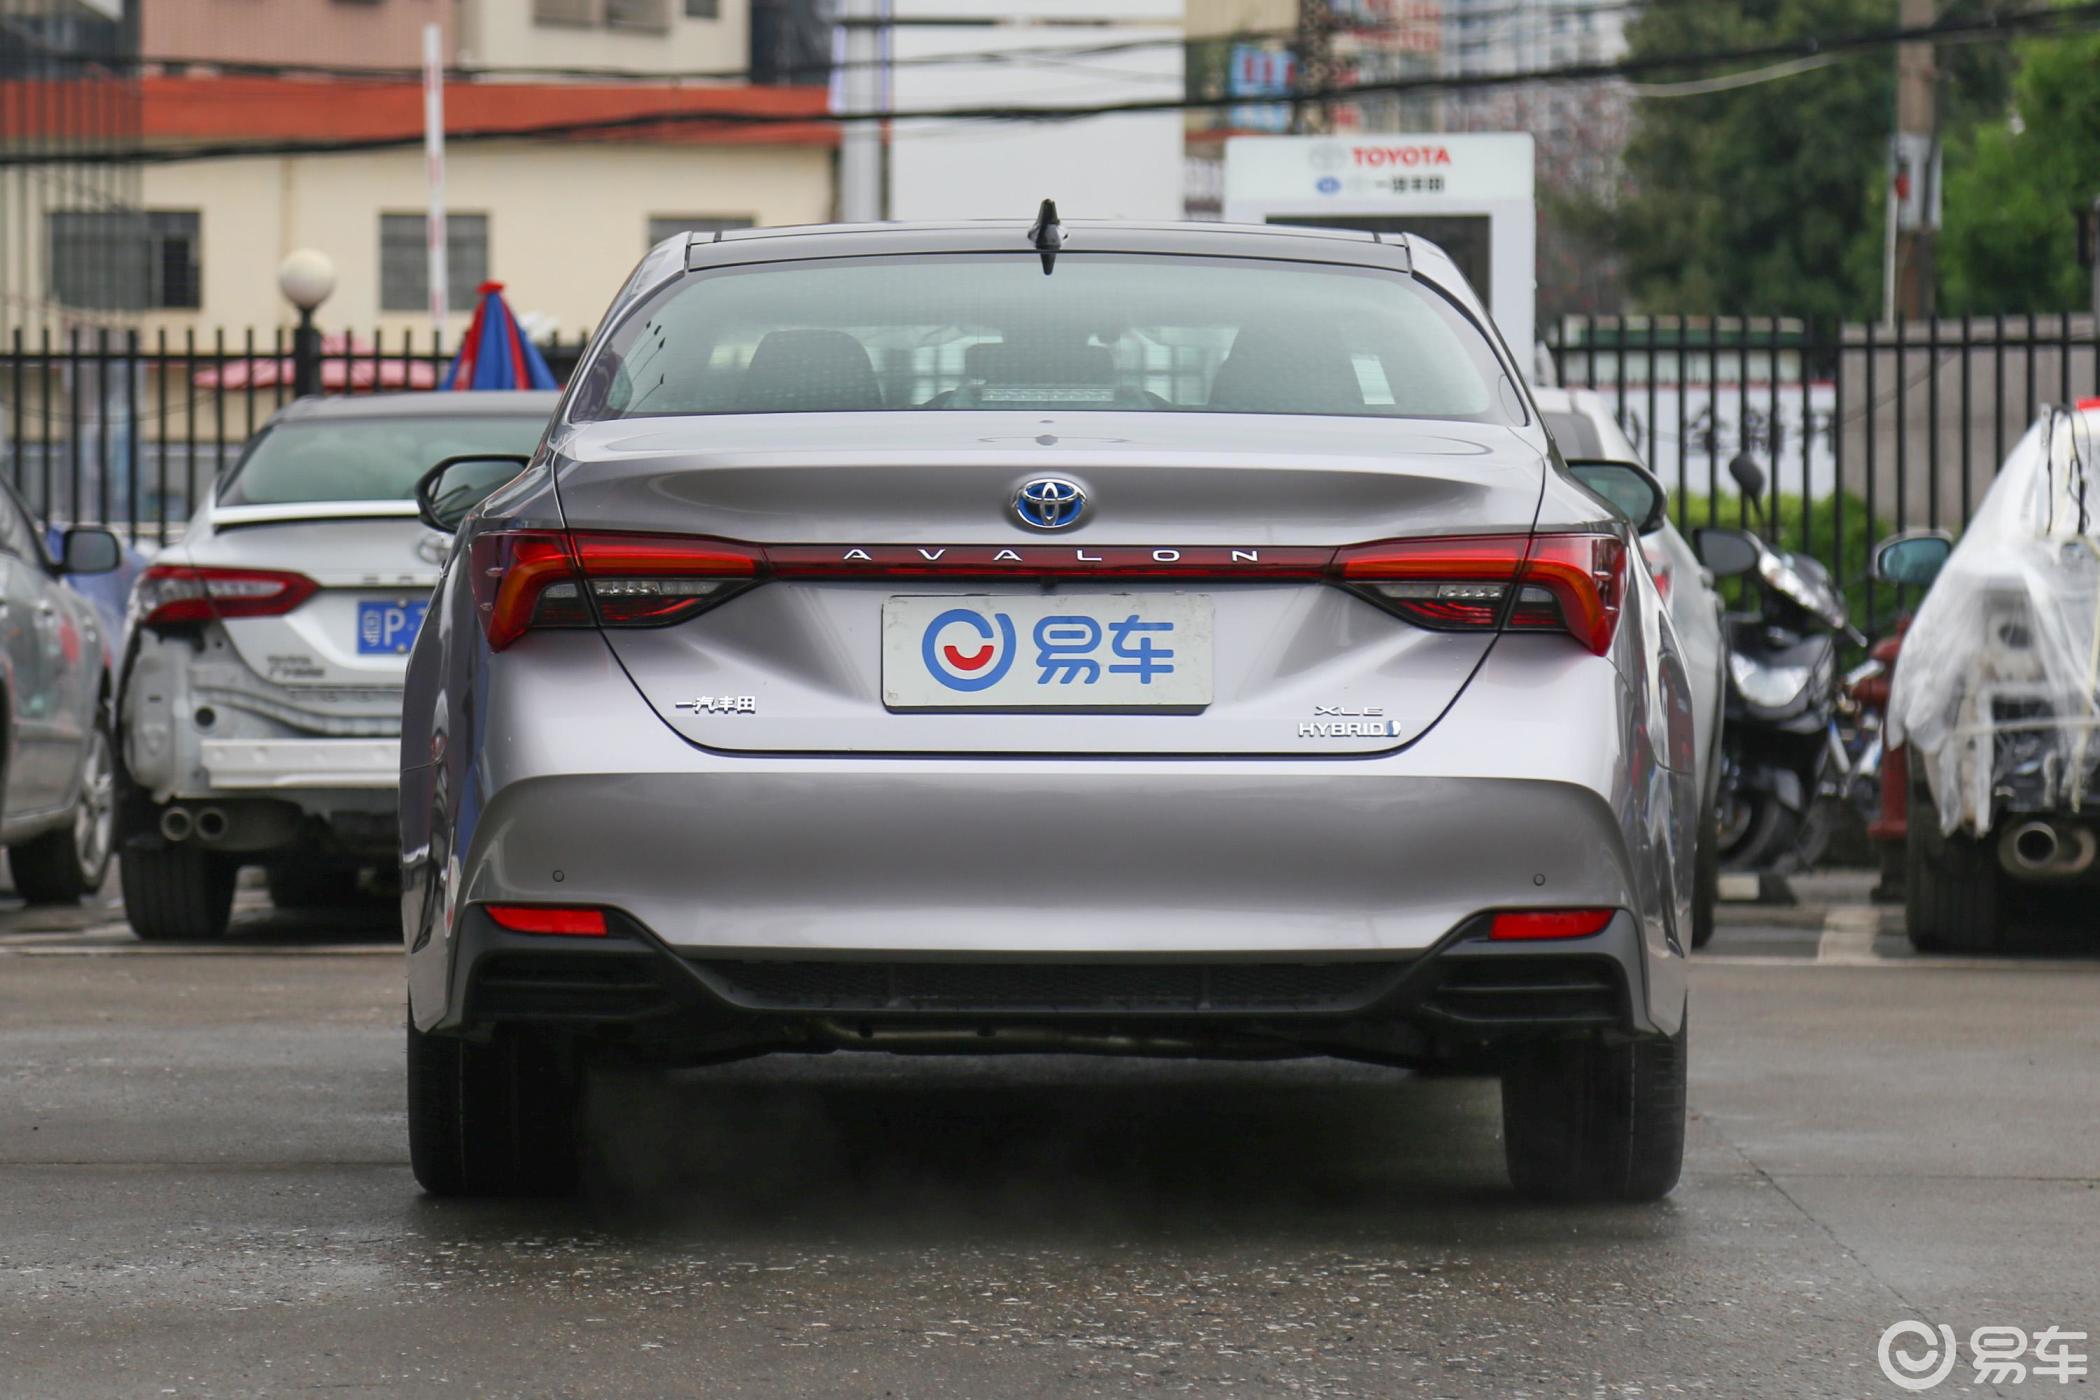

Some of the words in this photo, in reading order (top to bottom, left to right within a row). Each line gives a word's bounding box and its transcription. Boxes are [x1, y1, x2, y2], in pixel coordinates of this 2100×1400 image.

[1352, 146, 1451, 167] TOYOTA
[842, 548, 1259, 562] AVALON
[1032, 614, 1175, 685] 易车
[675, 695, 756, 714] 一汽丰田
[1314, 704, 1383, 717] XLE
[1298, 722, 1385, 738] HYBRID
